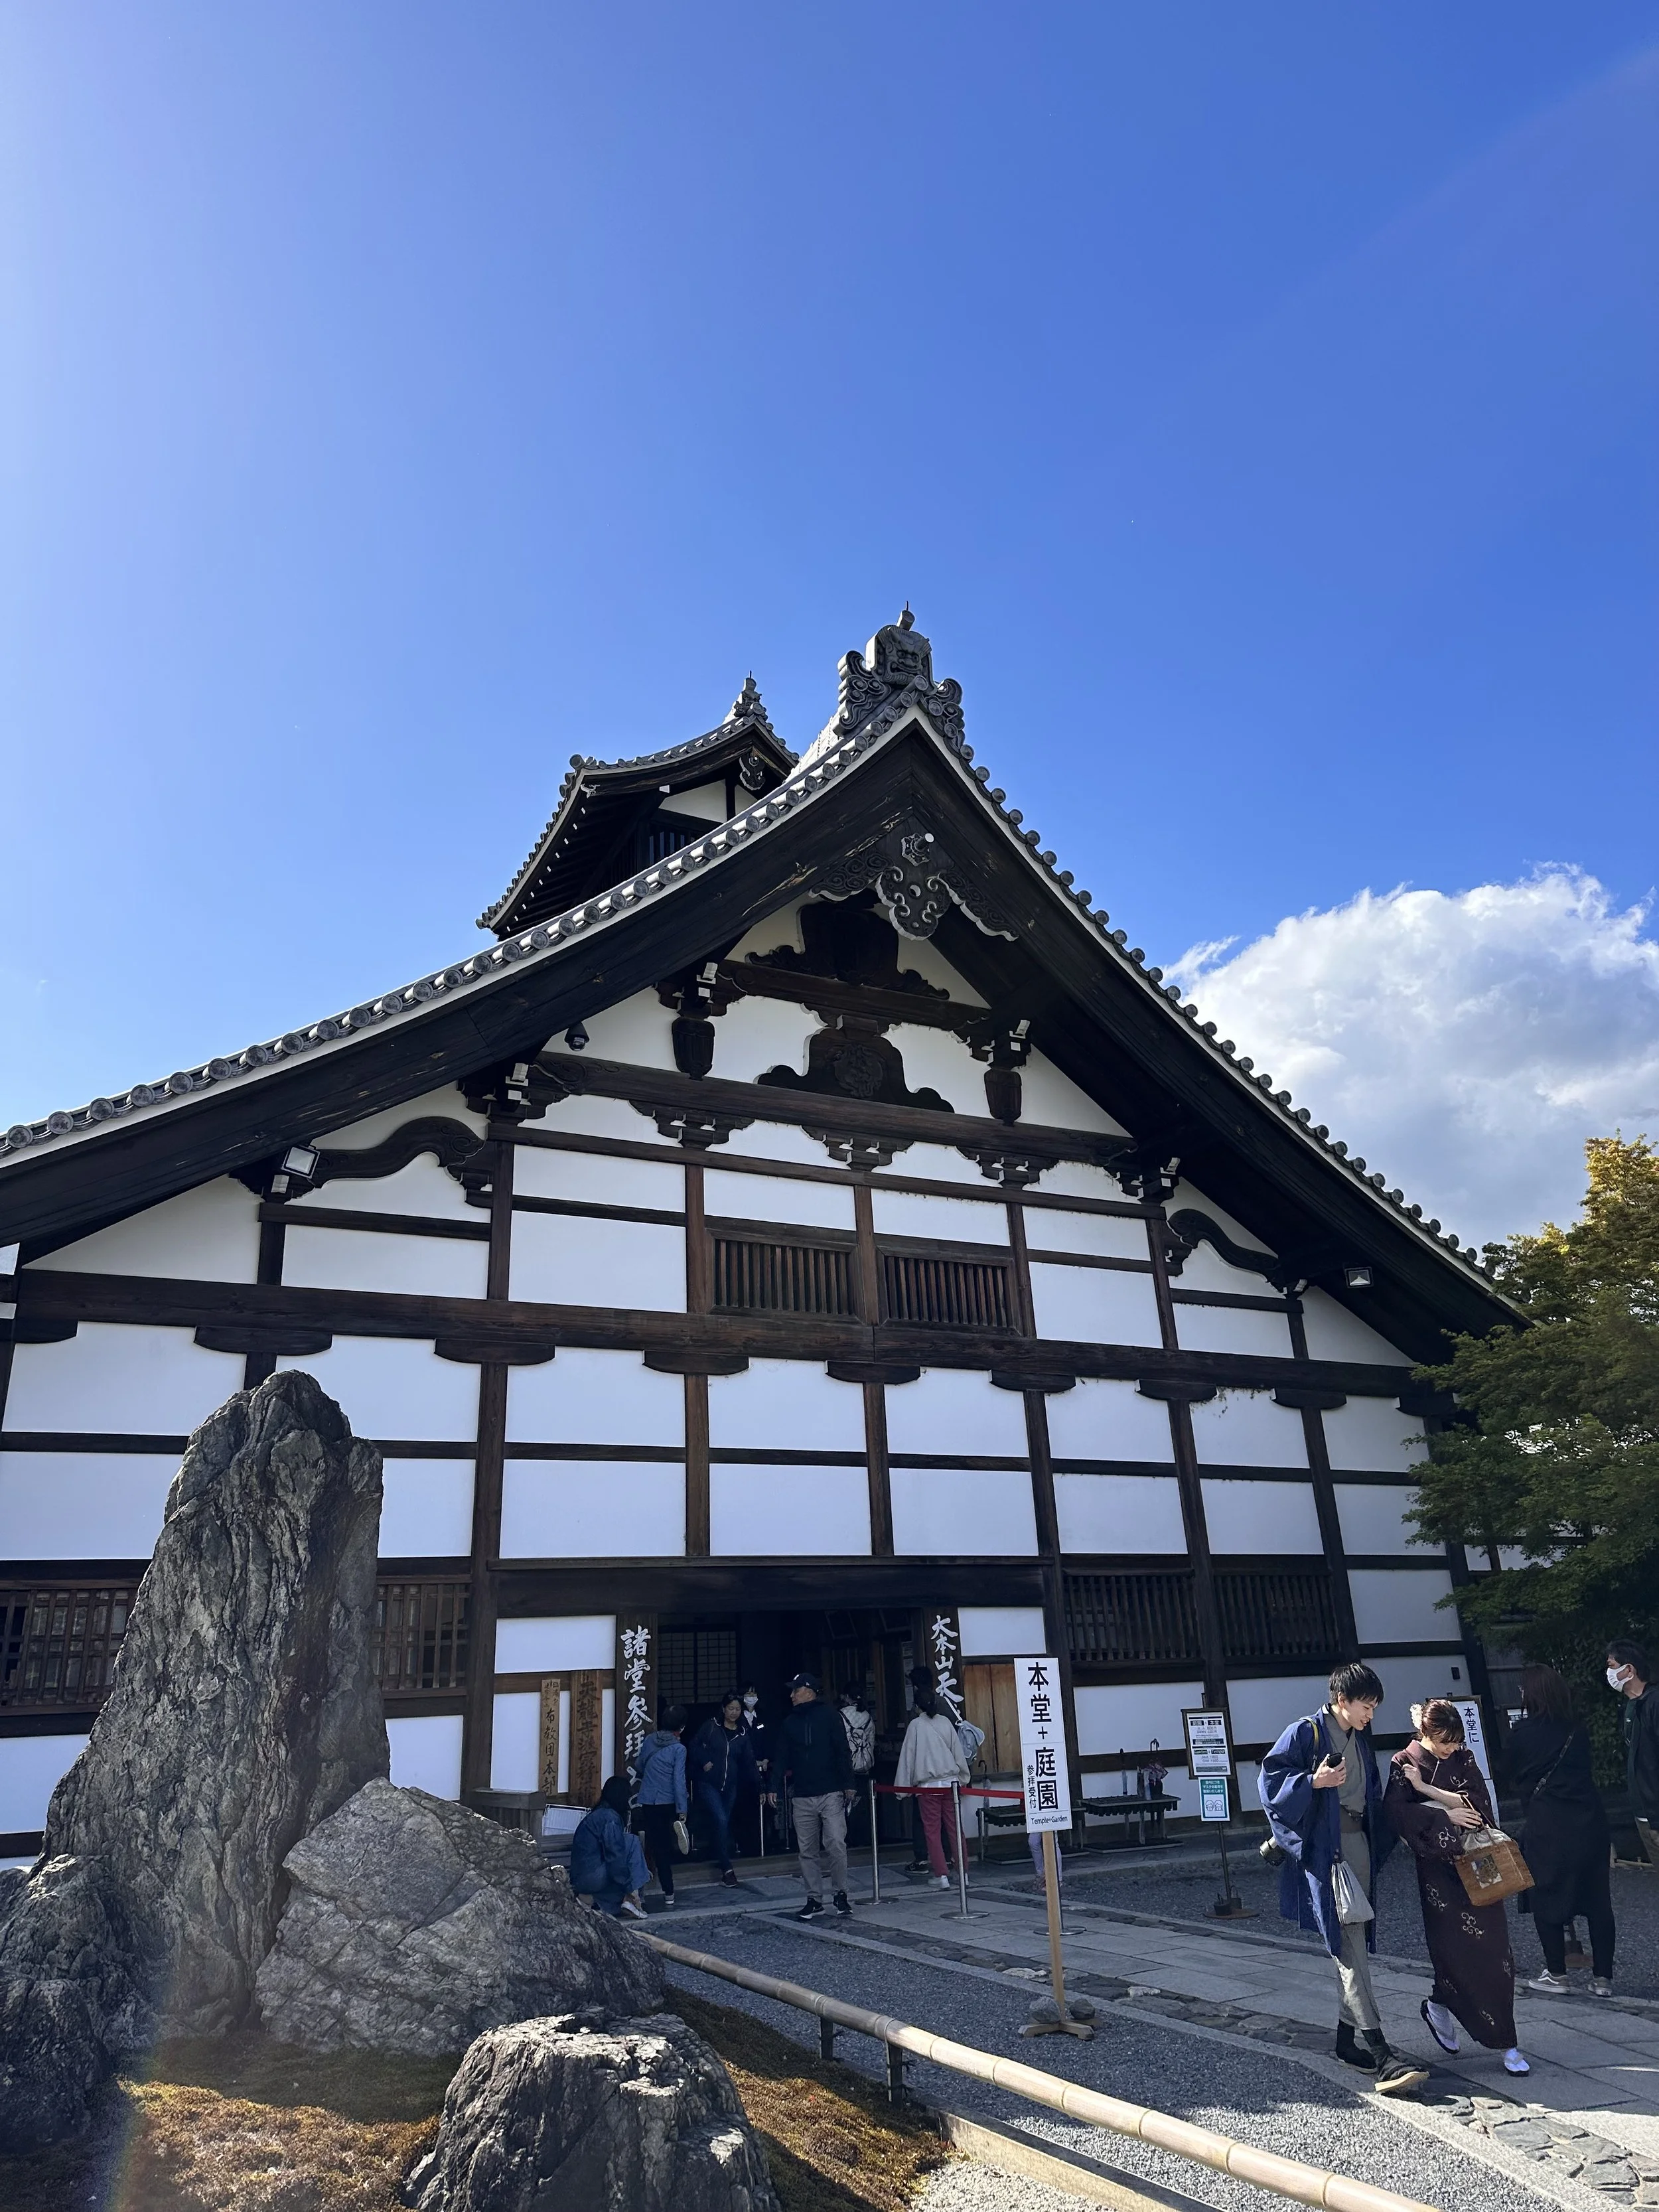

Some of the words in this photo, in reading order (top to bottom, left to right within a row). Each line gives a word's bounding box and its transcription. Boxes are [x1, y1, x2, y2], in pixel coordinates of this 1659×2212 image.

[930, 1615, 964, 1716] 大本山天
[1464, 1706, 1480, 1743] 本堂に
[1027, 1765, 1037, 1808] 参拝受付
